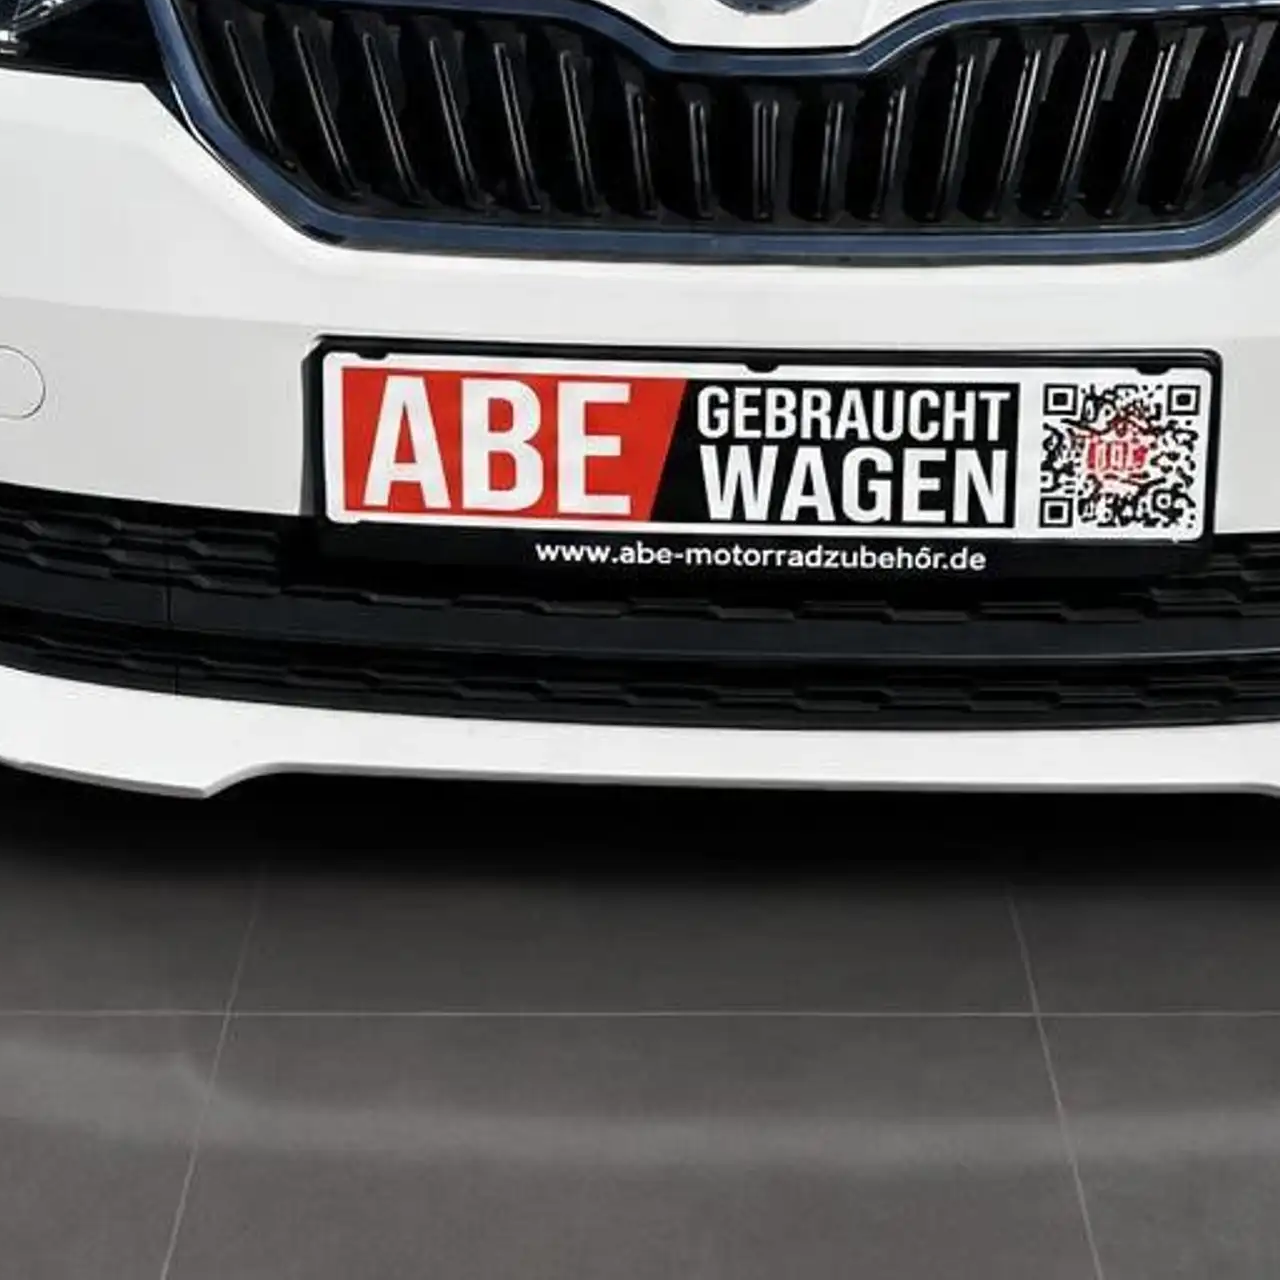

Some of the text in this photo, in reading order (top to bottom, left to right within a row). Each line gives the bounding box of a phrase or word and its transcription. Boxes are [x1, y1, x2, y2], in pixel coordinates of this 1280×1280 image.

[363, 375, 631, 516] ABE
[697, 385, 1011, 441] GEBRAUCHT
[699, 444, 1008, 523] WAGEN
